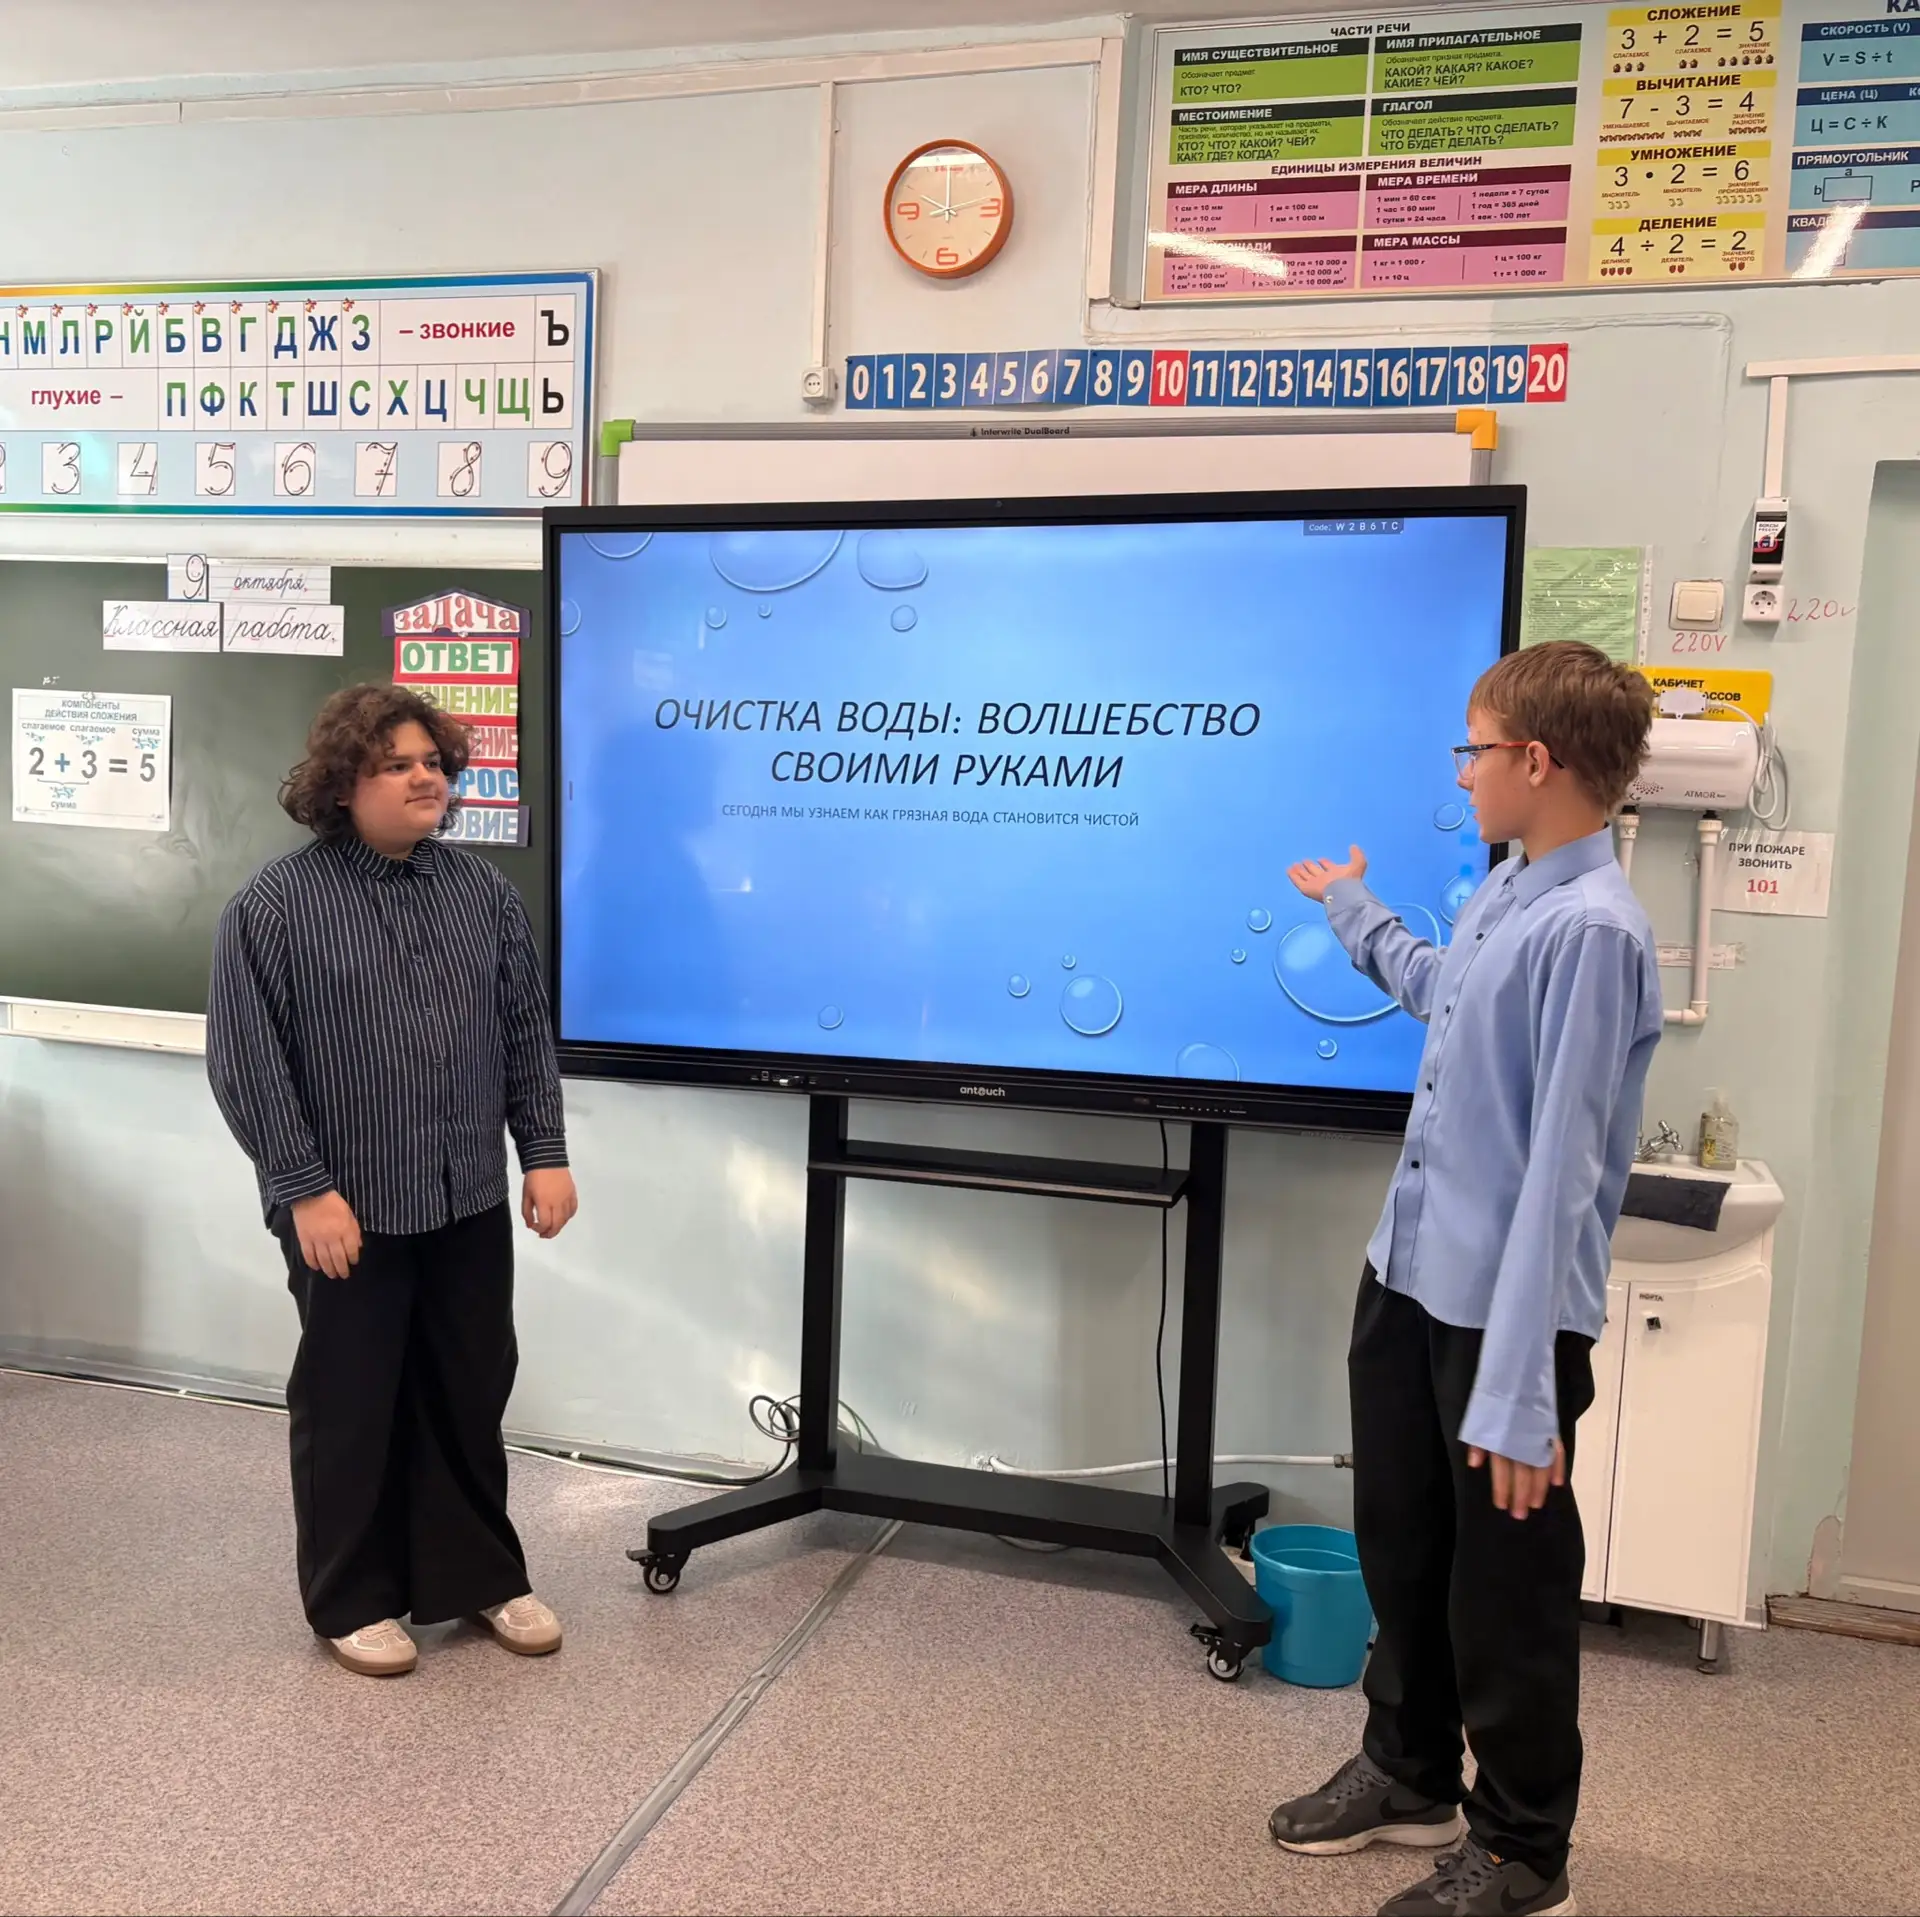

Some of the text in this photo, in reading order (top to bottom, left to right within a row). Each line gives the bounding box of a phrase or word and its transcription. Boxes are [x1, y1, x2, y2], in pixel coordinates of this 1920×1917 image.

[1647, 5, 1740, 20] СЛОЖЕНИЕ
[1330, 22, 1410, 36] ЧАСТИ РЕЧИ
[1621, 20, 1764, 50] 3 2 5
[1820, 22, 1910, 36] СКОРОСТЬ (V)
[1386, 30, 1541, 49] ИМЯ ПРИЛАГАТЕЛЬНОЕ
[1182, 44, 1338, 62] ИМЯ СУЩЕСТВИТЕЛЬНОЕ
[1385, 59, 1534, 78] КАКОЙ? КАКАЯ? КАКОЕ?
[1180, 84, 1242, 96] КТО? ЧТО?
[1636, 74, 1740, 90] ВЫЧИТАНИЕ
[1820, 91, 1856, 101] ЦЕНА
[1382, 100, 1432, 112] ГЛАГОЛ
[1620, 91, 1755, 118] 7 3 4
[1179, 108, 1272, 122] МЕСТОИМЕНИЕ
[1382, 121, 1559, 140] ЧТО ДЕЛАТЬ? ЧТО СДЕЛАТЬ?
[1177, 135, 1316, 151] КТО? ЧТО? КАКОЙ? ЧЕЙ?
[1380, 136, 1504, 150] ЧТО БУДЕТ ДЕЛАТЬ?
[1630, 144, 1736, 161] УМНОЖЕНИЕ
[1797, 151, 1908, 165] ПРЯМОУГОЛЬНИК
[1271, 156, 1482, 176] ЕДИНИЦЫ ИЗМЕРЕНИЯ ВЕЛИЧИН
[1176, 182, 1258, 194] МЕРА ДЛИНЫ
[1378, 174, 1478, 186] МЕРА ВРЕМЕНИ
[897, 202, 920, 220] 9
[980, 198, 1000, 218] 3
[1638, 216, 1717, 232] ДЕЛЕНИЕ
[1374, 235, 1460, 247] МЕРА МАССЫ
[936, 248, 958, 266] 6
[24, 319, 46, 354] М
[59, 319, 80, 354] Л
[94, 318, 114, 354] Р
[130, 308, 150, 354] Й
[164, 318, 186, 353] Б
[202, 317, 222, 353] В
[240, 317, 257, 352] Г
[274, 316, 297, 358] Д
[308, 314, 338, 352] Ж
[420, 318, 515, 341] звонкие
[852, 354, 1565, 400] 0 1 2 3 4 5 6 7 8 9 10 11 12 13 14 15 16 17 18 19 20
[31, 386, 101, 407] глухие
[982, 426, 1070, 436] Interwrite DualBoard
[52, 442, 572, 496] 3 4 5 6 7 8 9
[1309, 524, 1332, 532] Code:
[104, 606, 218, 638] Классная
[402, 642, 512, 672] ОТВЕТ
[1653, 678, 1704, 688] КАБИНЕТ
[62, 700, 120, 710] КОМПОНЕНТЫ
[409, 686, 518, 714] ШЕНИЕ
[45, 708, 137, 721] ДЕЙСТВИЯ СЛОЖЕНИЯ
[655, 698, 1260, 740] ОЧИСТКА ВОДЫ: ВОЛШЕБСТВО
[22, 722, 160, 736] слагаемое слагаемое сумма
[28, 747, 156, 782] 2 3 5
[771, 751, 1124, 788] СВОИМИ РУКАМИ
[450, 768, 519, 799] РОС
[1684, 790, 1716, 798] ATMOR
[722, 804, 1139, 826] СЕГОДНЯ МЫ УЗНАЕМ КАК ГРЯЗНАЯ ВОДА СТАНОВИТСЯ ЧИСТОЙ
[1728, 842, 1805, 856] ПРИ ПОЖАРЕ
[1738, 858, 1792, 870] ЗВОНИТЬ
[1747, 879, 1778, 894] 101
